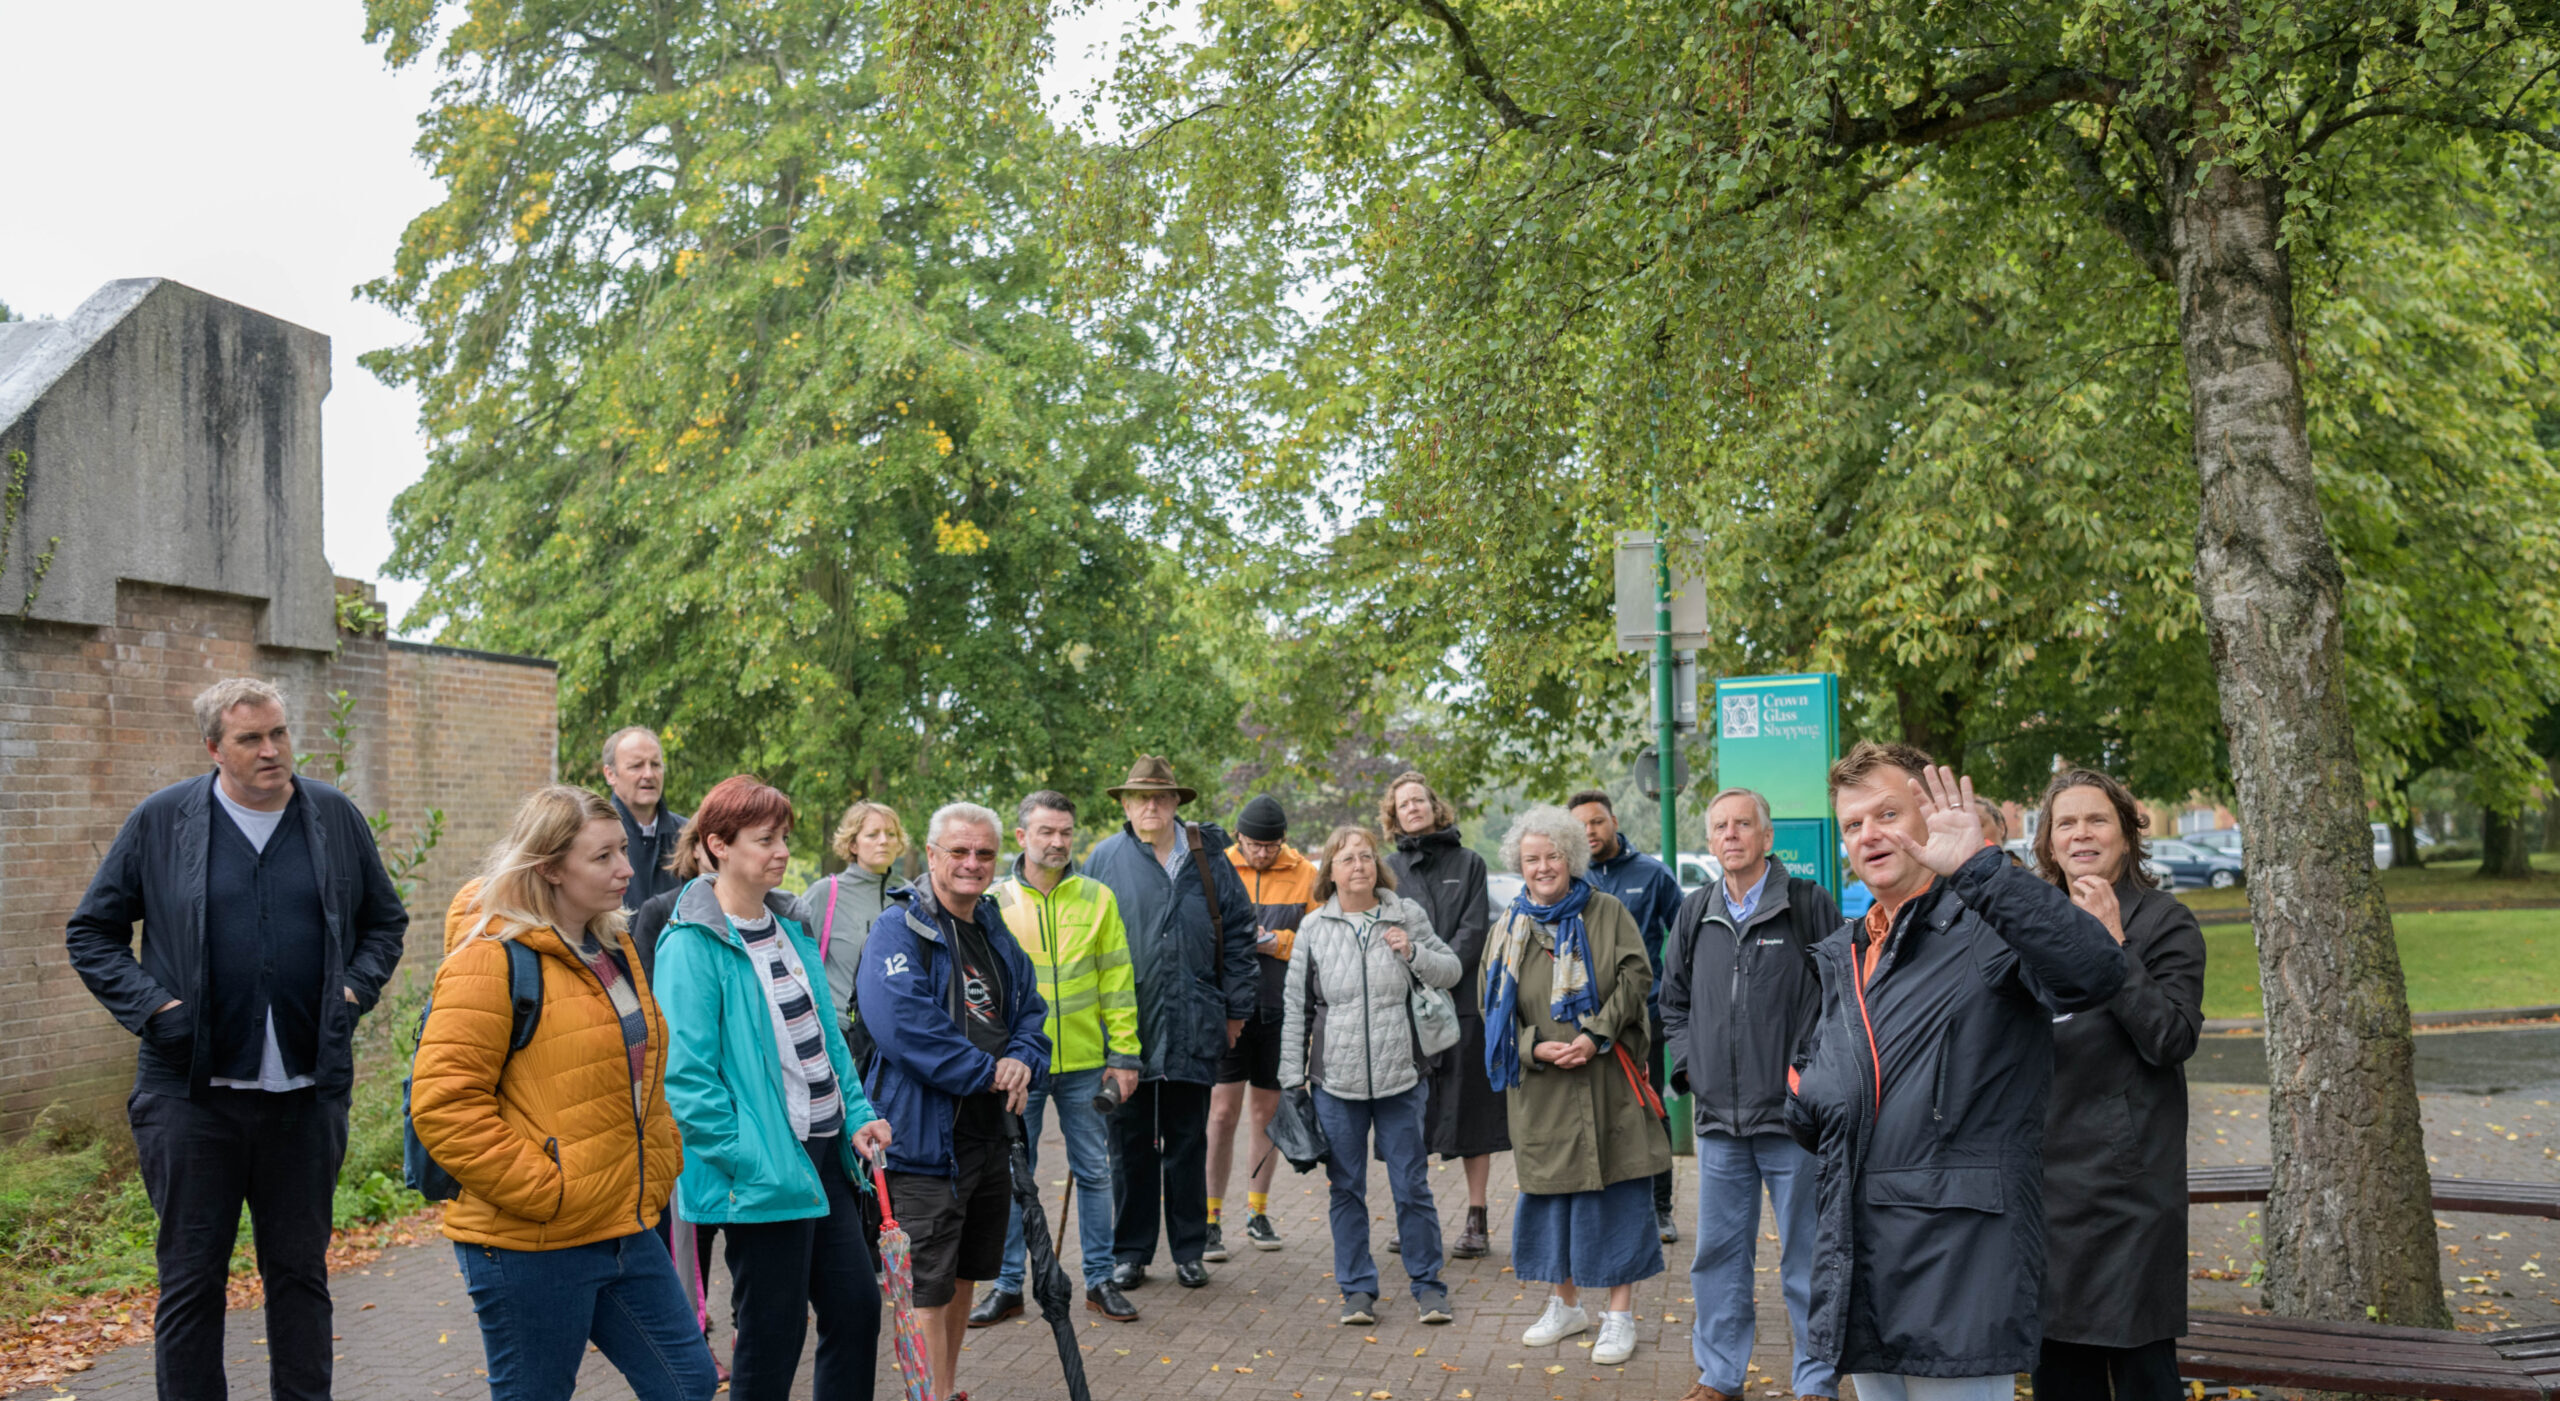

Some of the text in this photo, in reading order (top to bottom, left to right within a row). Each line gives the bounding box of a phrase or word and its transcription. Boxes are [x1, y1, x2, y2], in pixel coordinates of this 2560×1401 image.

[1763, 693, 1808, 707] Crown
[1763, 708, 1797, 722] Glass
[1763, 722, 1820, 740] Shopping
[884, 953, 909, 976] 12
[968, 987, 984, 995] MINI
